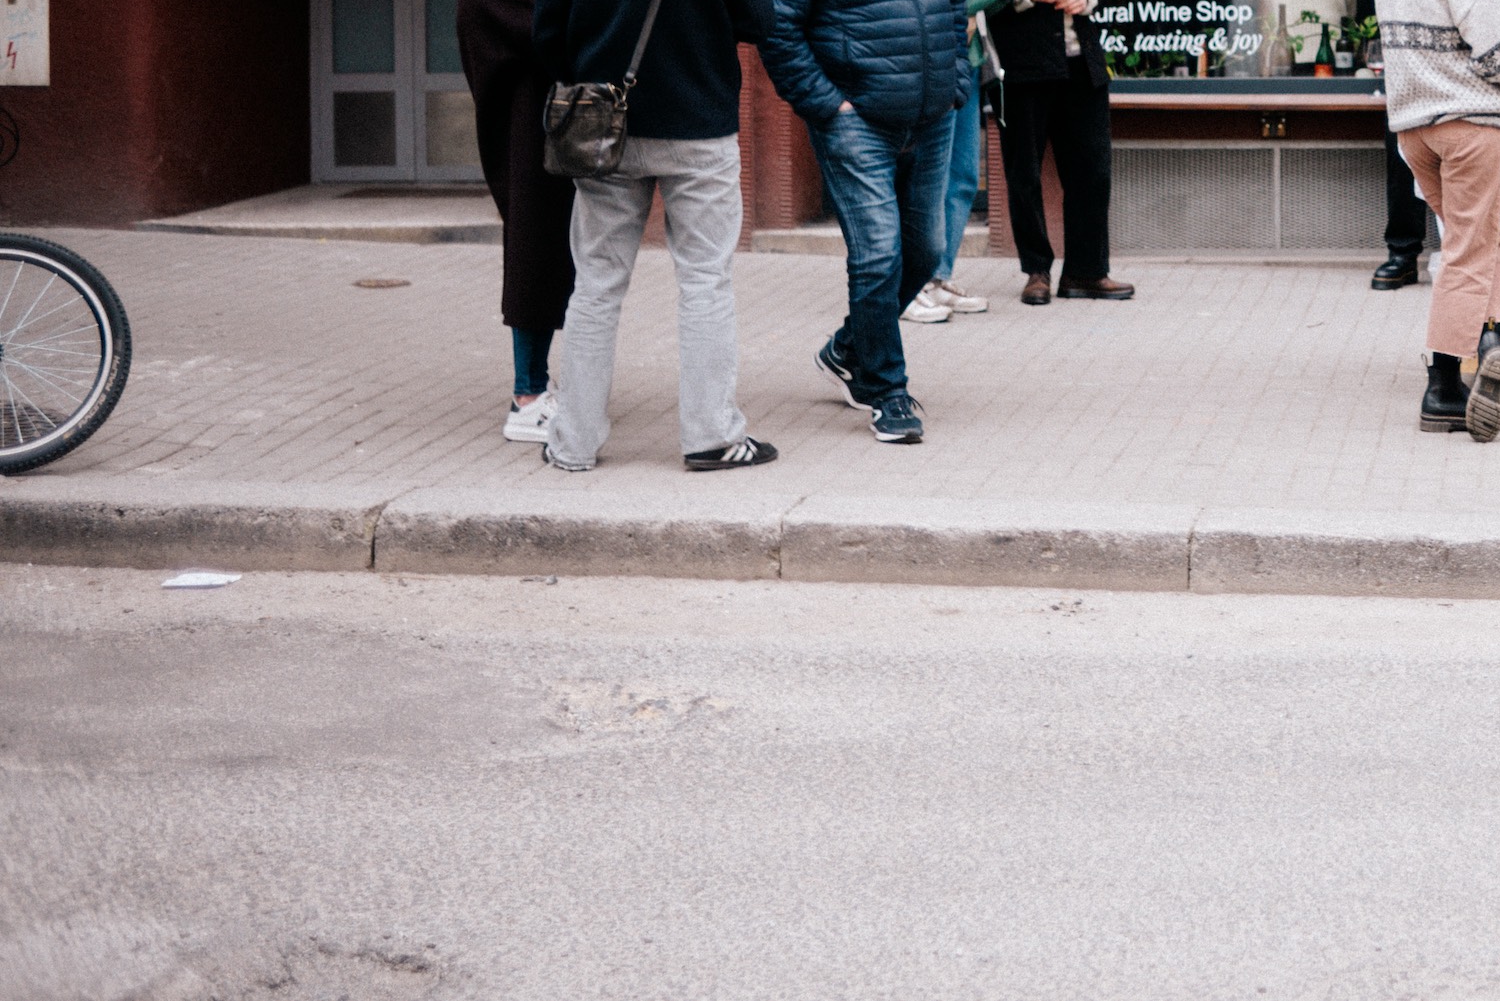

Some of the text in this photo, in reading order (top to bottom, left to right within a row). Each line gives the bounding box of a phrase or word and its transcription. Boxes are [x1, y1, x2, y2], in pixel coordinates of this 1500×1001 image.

[1137, 1, 1192, 23] Wine
[1196, 0, 1253, 25] Shop
[1099, 27, 1264, 56] les, tasting & joy
